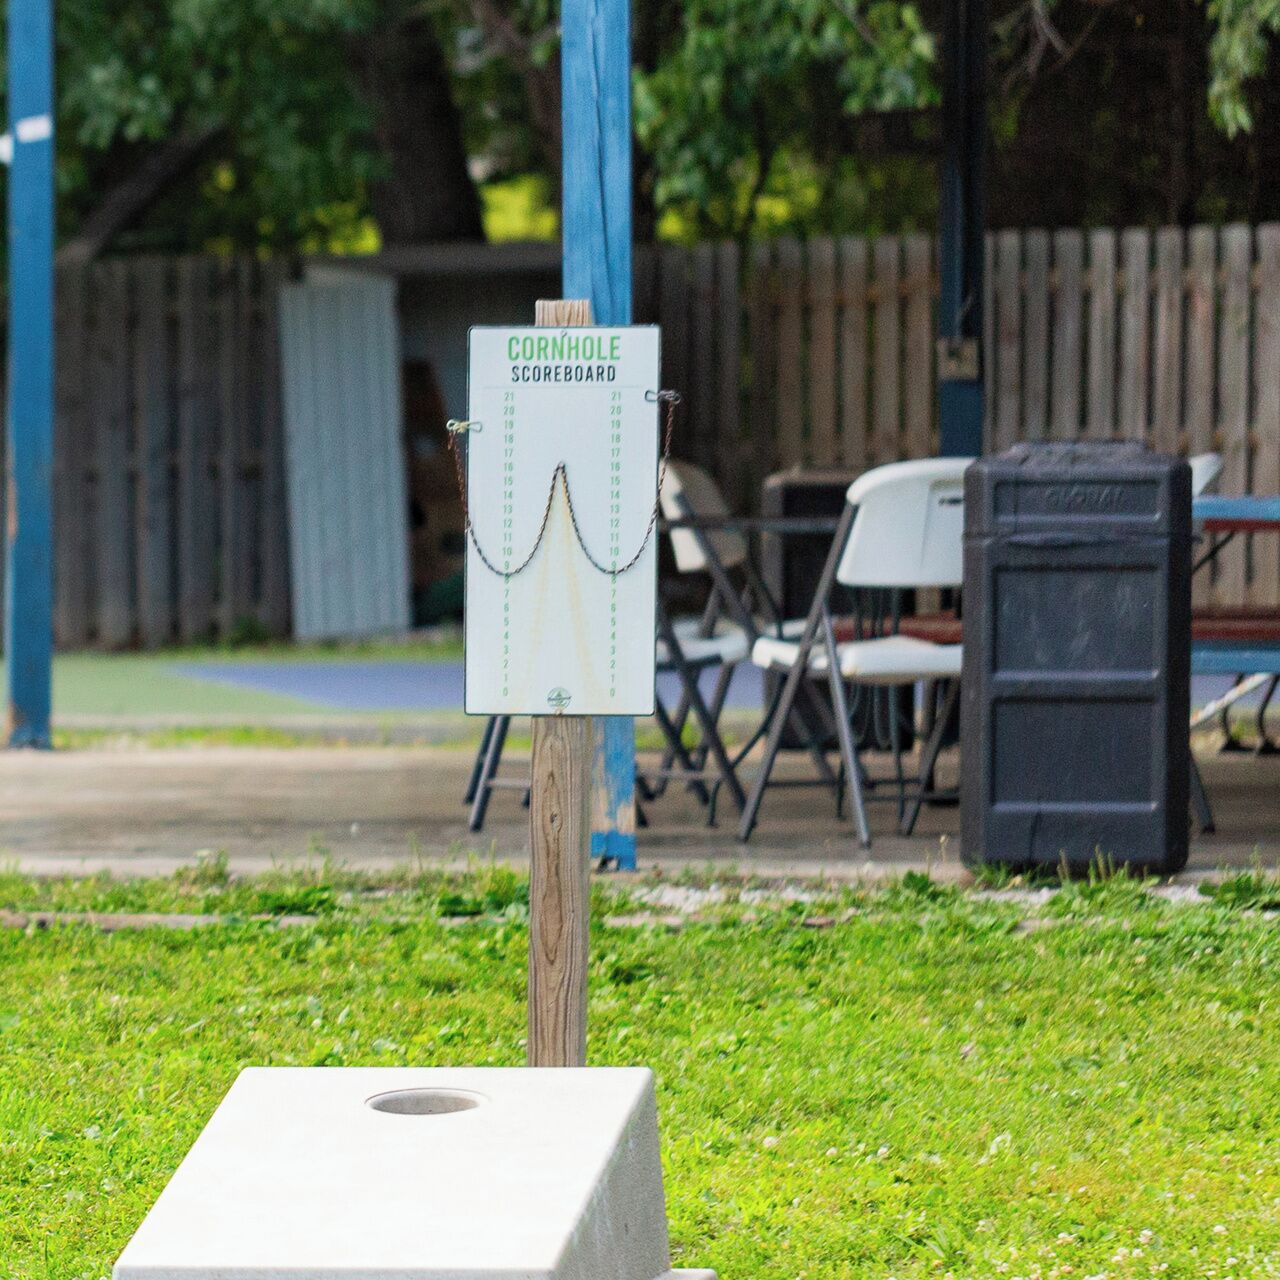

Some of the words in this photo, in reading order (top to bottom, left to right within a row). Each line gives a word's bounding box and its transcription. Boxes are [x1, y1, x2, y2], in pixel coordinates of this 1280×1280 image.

[508, 335, 621, 361] CORNHOLE
[511, 365, 616, 383] SCOREBOARD
[504, 392, 514, 402] 21
[611, 391, 621, 401] 21
[504, 405, 515, 415] 20
[610, 405, 622, 415] 20
[504, 419, 514, 430] 19
[611, 419, 621, 429] 19
[504, 433, 514, 444] 18
[611, 433, 621, 444] 18
[504, 448, 513, 458] 17
[611, 447, 620, 458] 17
[504, 462, 513, 472] 16
[610, 462, 621, 472] 16
[504, 476, 513, 486] 15
[610, 476, 620, 486] 15
[504, 490, 513, 500] 14
[610, 490, 620, 500] 14
[503, 504, 512, 514] 13
[610, 504, 620, 514] 13
[503, 518, 513, 528] 12
[610, 518, 620, 528] 12
[503, 533, 512, 542] 11
[610, 532, 619, 543] 11
[502, 546, 513, 556] 10
[610, 546, 620, 556] 10
